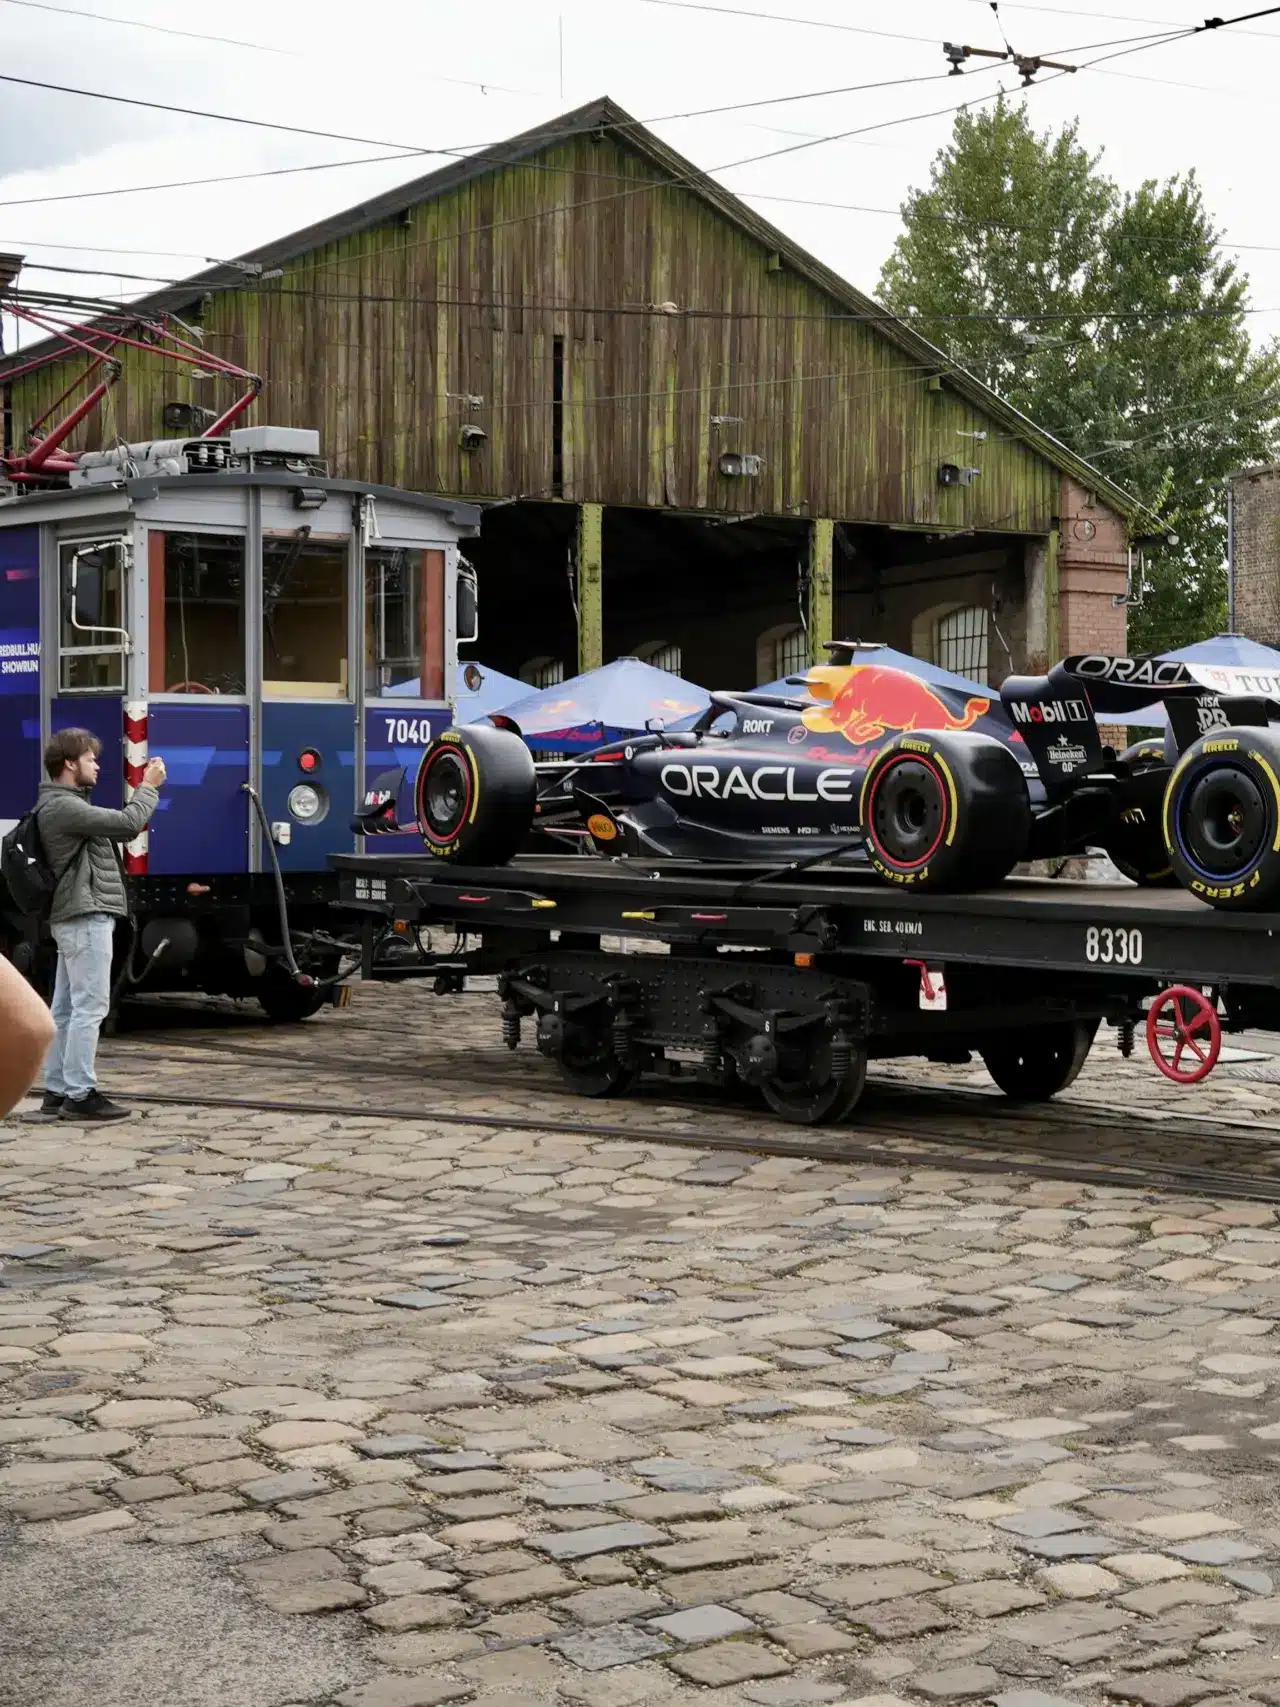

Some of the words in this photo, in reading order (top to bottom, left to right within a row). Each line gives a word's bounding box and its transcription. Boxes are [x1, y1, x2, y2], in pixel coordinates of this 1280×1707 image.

[2, 660, 39, 673] SHOWRUN
[1075, 656, 1199, 684] ORACL
[1196, 697, 1220, 707] VISA
[1010, 700, 1067, 723] Mobil
[385, 719, 431, 743] 7040
[743, 720, 774, 734] ROKT
[900, 739, 931, 753] PIRELLI
[1202, 738, 1239, 754] PIRELLI
[1050, 749, 1085, 760] Heineken
[661, 764, 856, 802] ORACLE
[762, 826, 790, 834] SIEMENS
[840, 825, 861, 834] HEXAGO
[873, 860, 916, 884] ZERO
[1250, 869, 1261, 888] P
[1191, 879, 1246, 899] ZERO
[1085, 926, 1143, 965] 8330
[765, 1020, 770, 1032] 6
